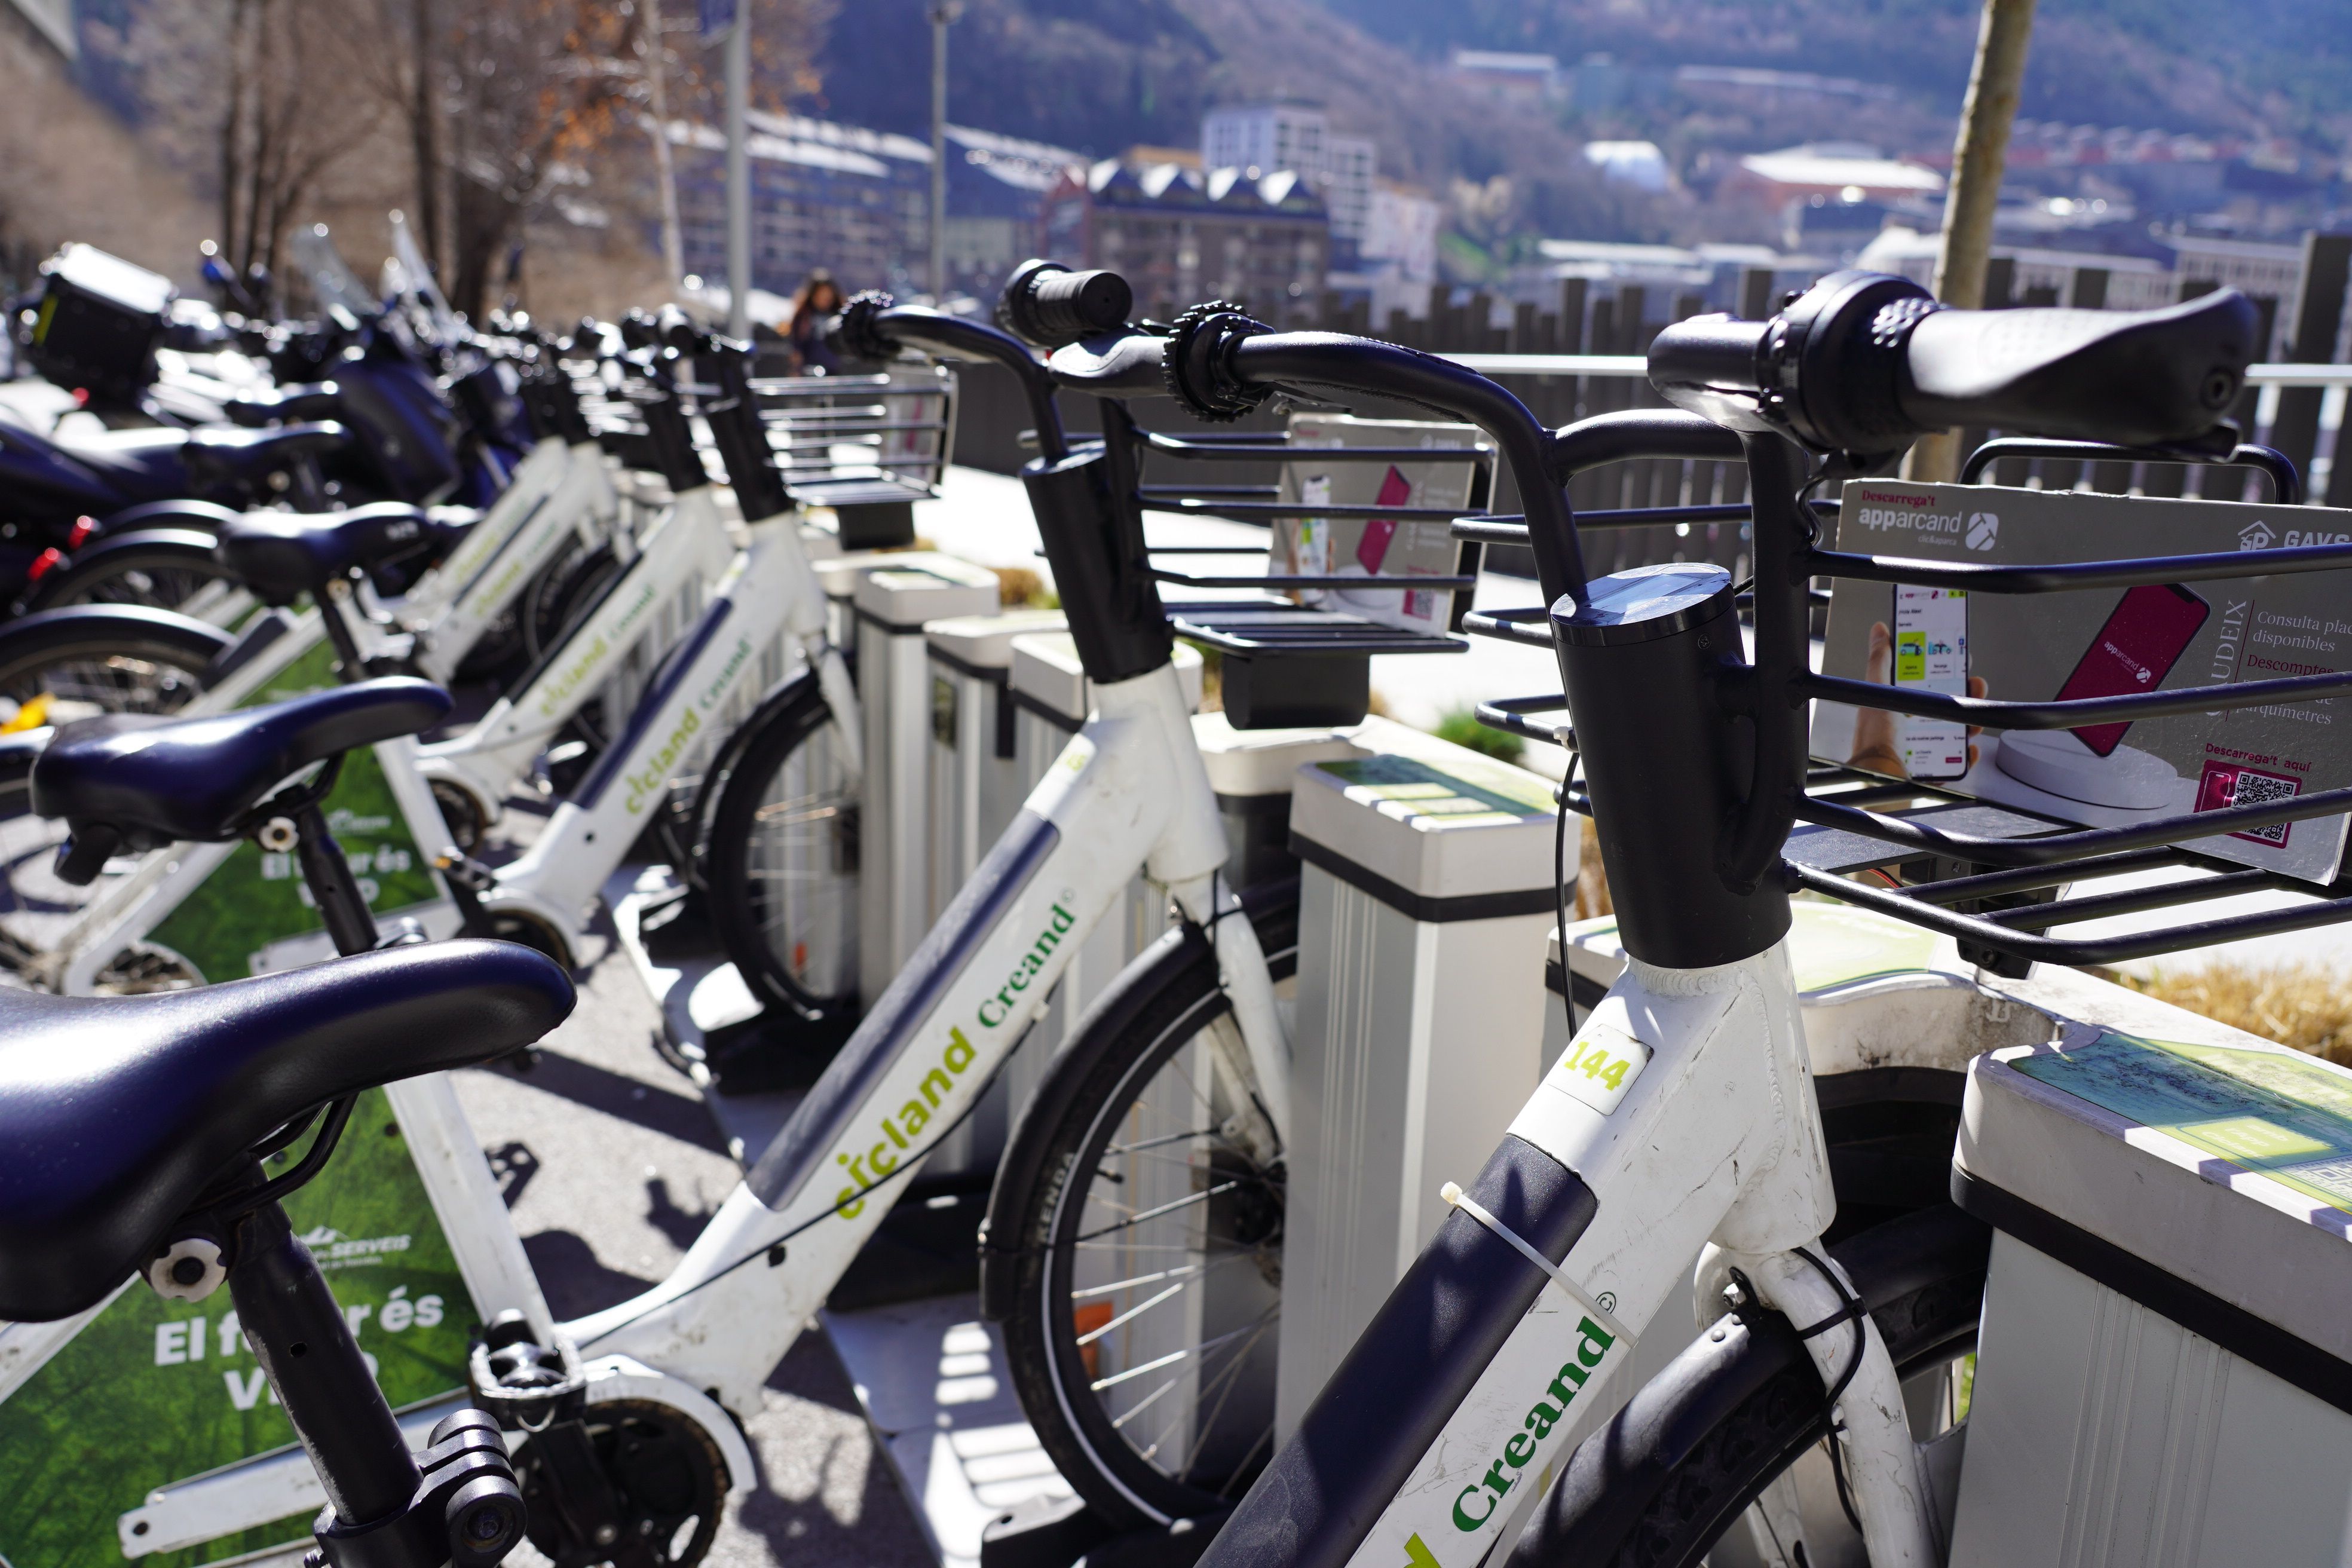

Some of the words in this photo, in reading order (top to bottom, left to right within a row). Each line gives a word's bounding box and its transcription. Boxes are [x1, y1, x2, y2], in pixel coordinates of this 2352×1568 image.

[1862, 490, 1936, 507] Descarrega't
[1858, 508, 1962, 533] apparcand
[2258, 611, 2320, 630] Consulta
[2253, 629, 2335, 652] disponibles
[2104, 641, 2140, 670] apparcand
[2205, 599, 2247, 716] UDEIX
[2206, 743, 2278, 765] Descarrega't
[2284, 760, 2311, 772] aquí
[835, 1025, 978, 1220] cicland
[977, 902, 1076, 1028] Creand
[1563, 1041, 1631, 1091] 144
[331, 1234, 411, 1257] SERVEIS
[154, 1316, 206, 1367] El
[379, 1285, 445, 1333] és
[1452, 1315, 1616, 1532] Creand
